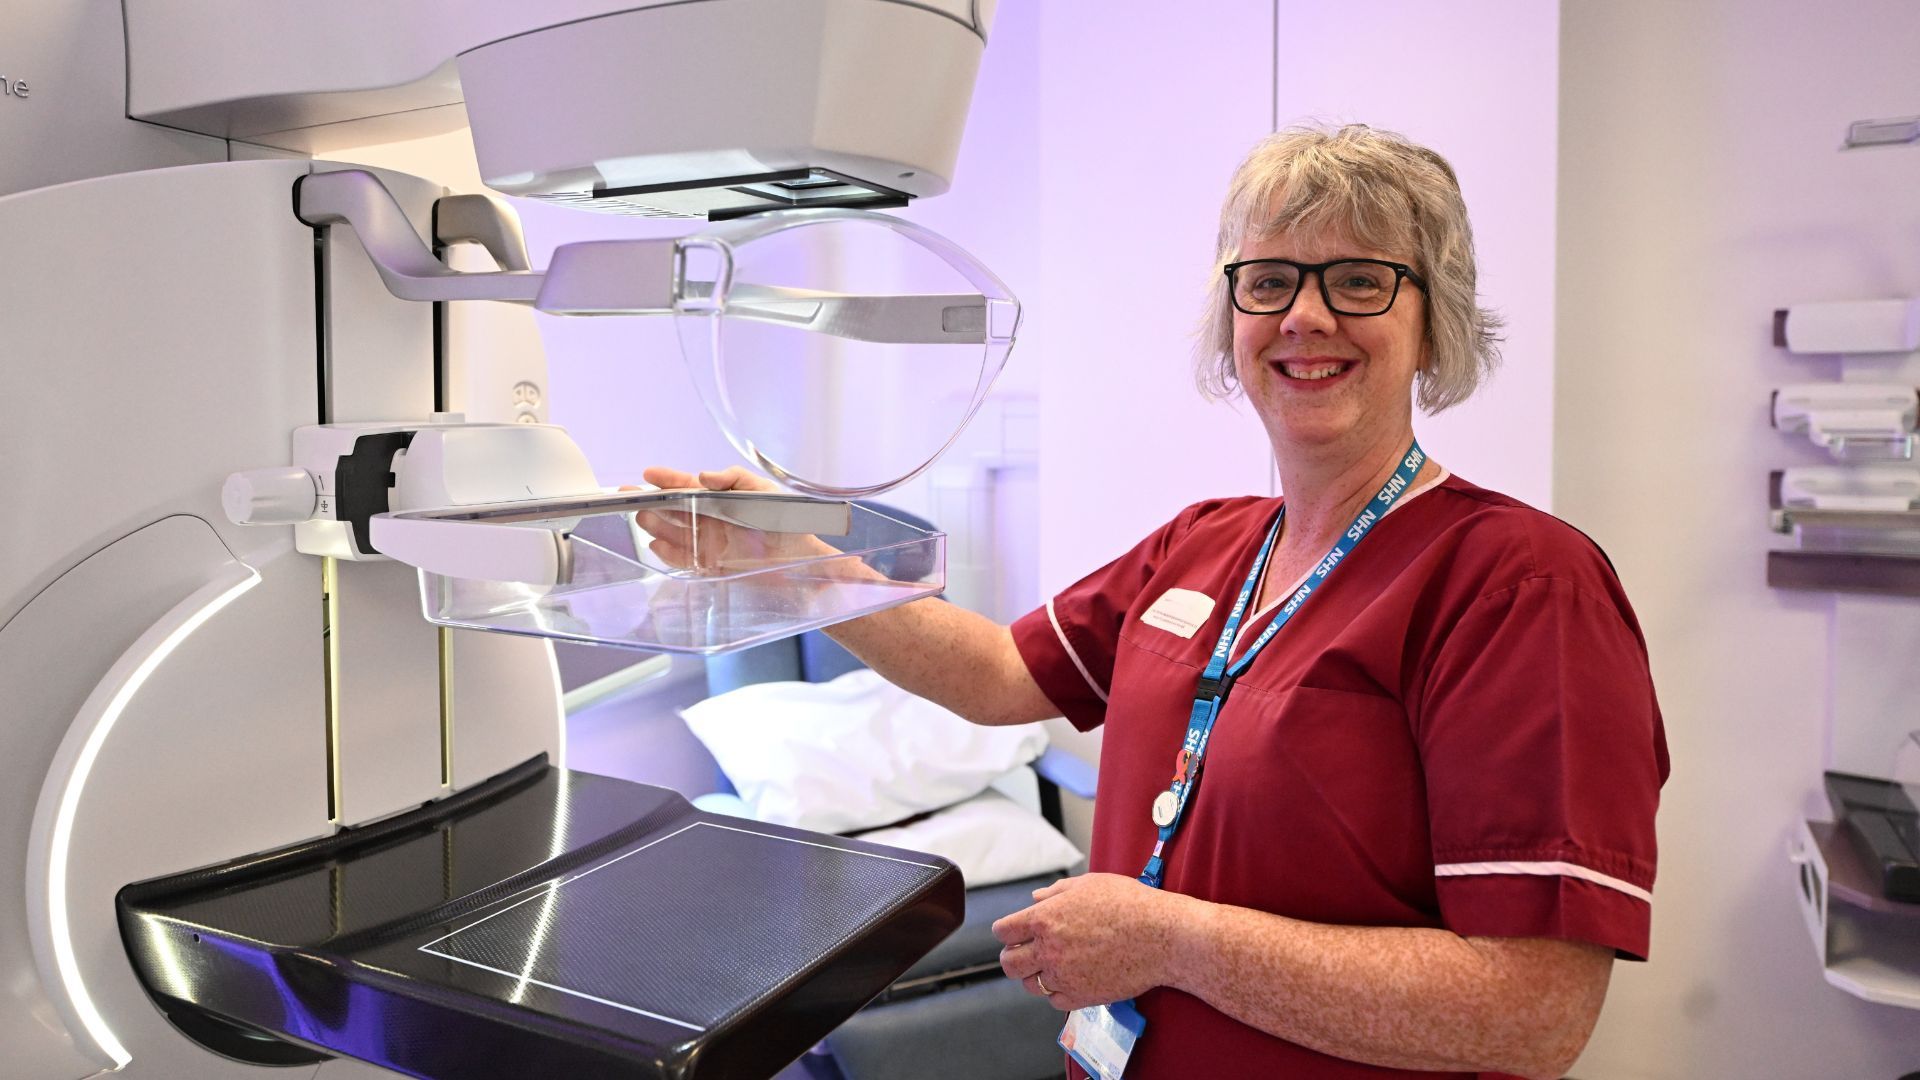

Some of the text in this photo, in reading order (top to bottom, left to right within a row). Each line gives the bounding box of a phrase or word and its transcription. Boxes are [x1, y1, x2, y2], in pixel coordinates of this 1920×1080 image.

[1405, 448, 1423, 472] NHS
[1377, 474, 1407, 505] NHS
[1347, 509, 1377, 541] NHS
[1316, 547, 1344, 578] NHS
[1231, 590, 1250, 618] NHS
[1284, 584, 1312, 616] NHS
[1215, 628, 1234, 658] NHS
[1251, 622, 1279, 652] NHS
[1185, 728, 1200, 755] HS
